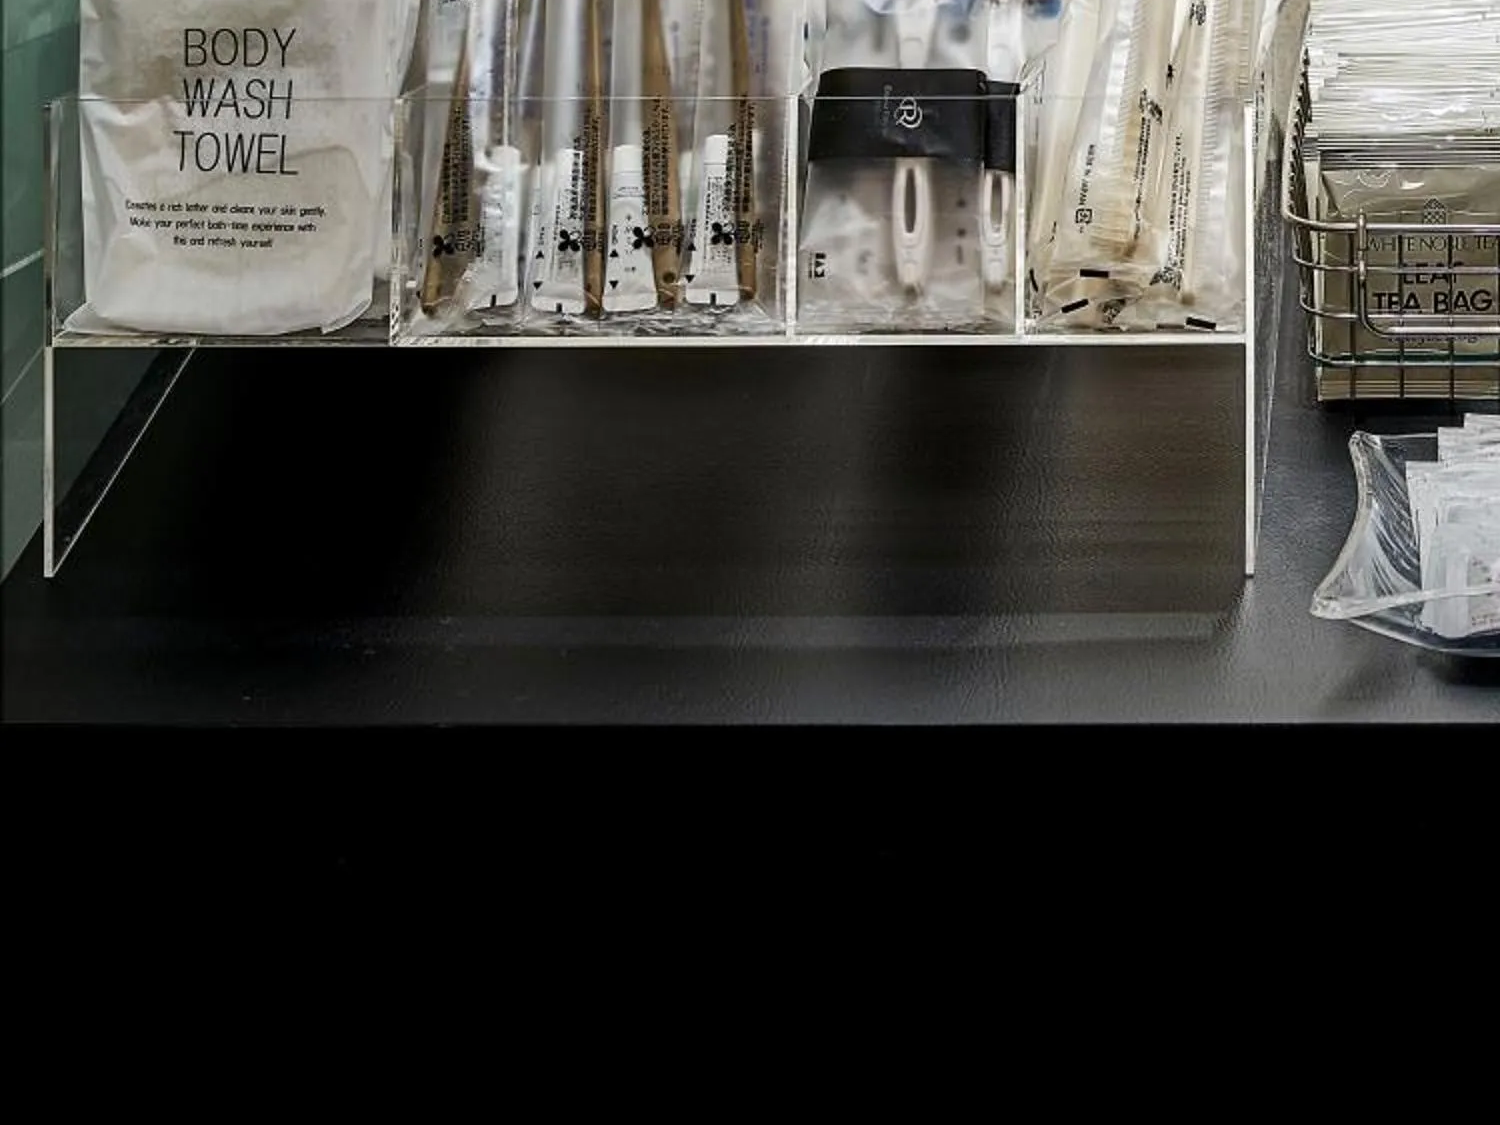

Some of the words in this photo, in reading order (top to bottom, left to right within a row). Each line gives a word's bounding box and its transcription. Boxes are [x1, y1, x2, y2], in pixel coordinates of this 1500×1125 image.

[184, 28, 296, 67] BODY
[183, 78, 292, 119] WASH
[173, 130, 299, 175] TOWEL
[212, 203, 226, 214] and
[257, 206, 275, 216] your
[280, 206, 296, 216] skin
[129, 216, 151, 228] Make
[154, 218, 172, 229] your
[175, 218, 204, 230] perfect
[297, 221, 317, 233] with
[189, 236, 204, 246] and
[1372, 292, 1421, 314] TEA
[1432, 289, 1493, 314] BAG
